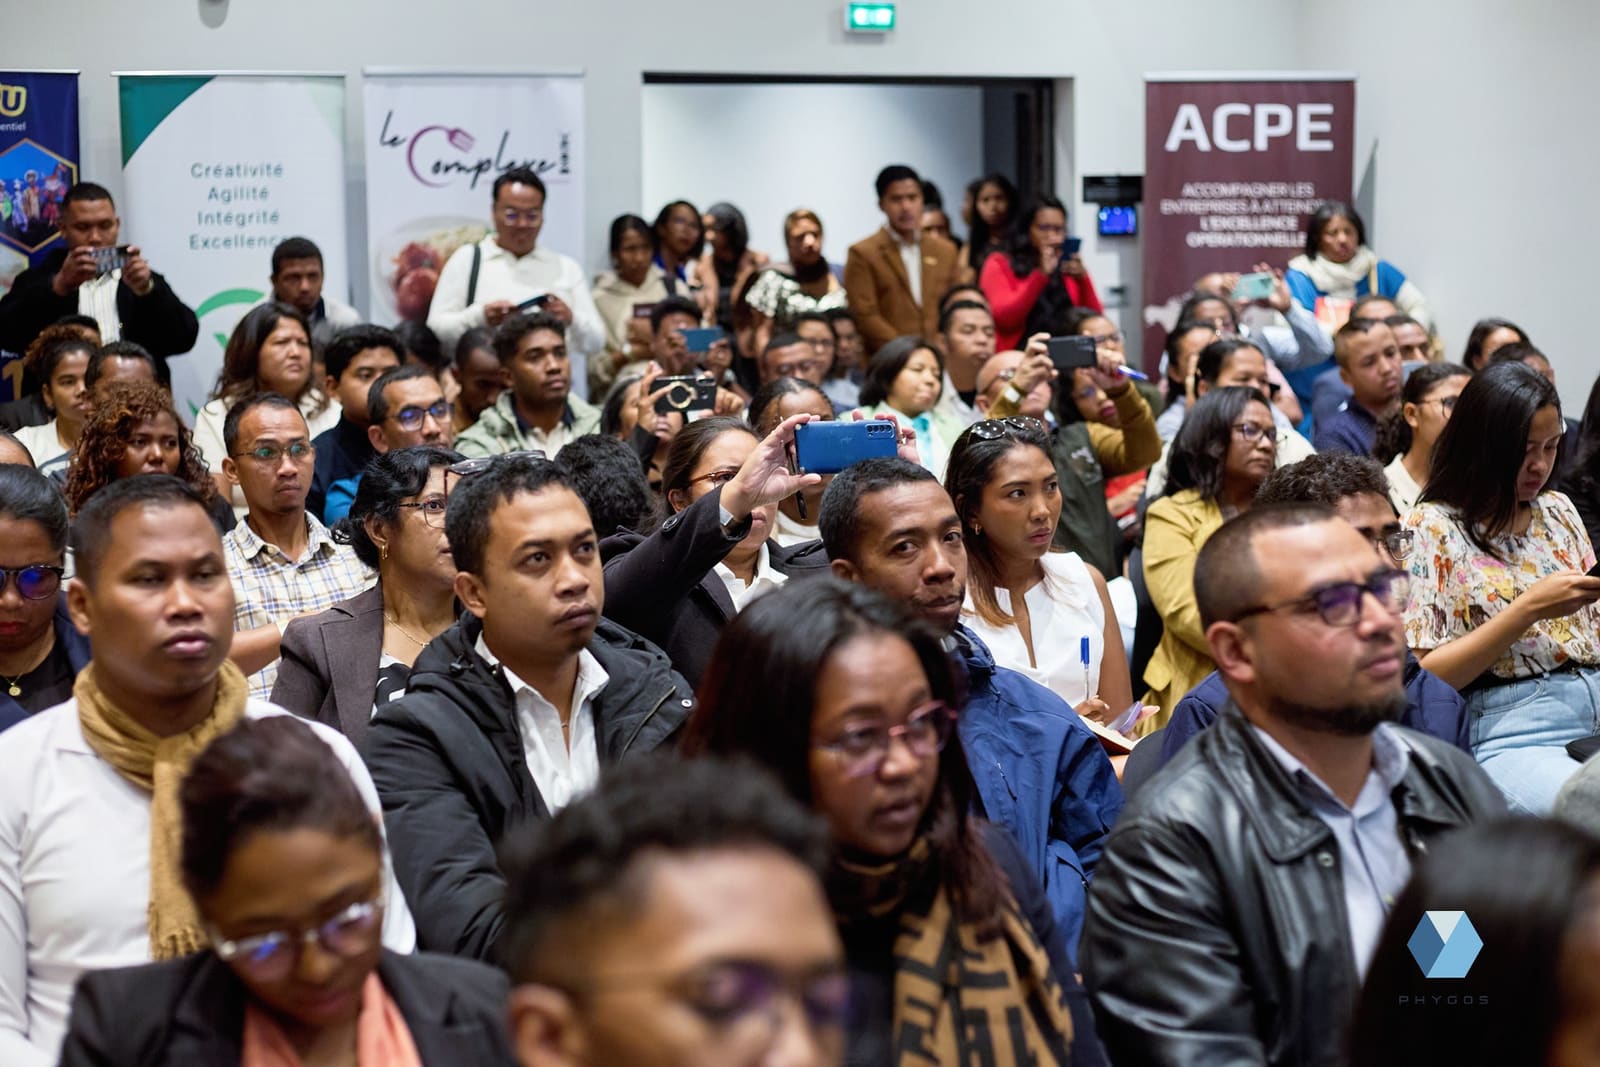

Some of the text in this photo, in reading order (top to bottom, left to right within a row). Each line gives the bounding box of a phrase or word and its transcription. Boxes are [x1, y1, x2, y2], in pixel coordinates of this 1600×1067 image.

[1164, 103, 1335, 152] ACPE
[405, 125, 556, 190] Complexe
[190, 162, 283, 178] Créativité
[207, 186, 268, 205] Agilité
[1182, 182, 1315, 198] ACCOMPAGNER LES
[1160, 199, 1250, 215] ENTREPRISES
[197, 210, 280, 228] Intégrité
[1200, 215, 1299, 231] L'EXCELLENCE
[189, 233, 288, 250] Excellenc
